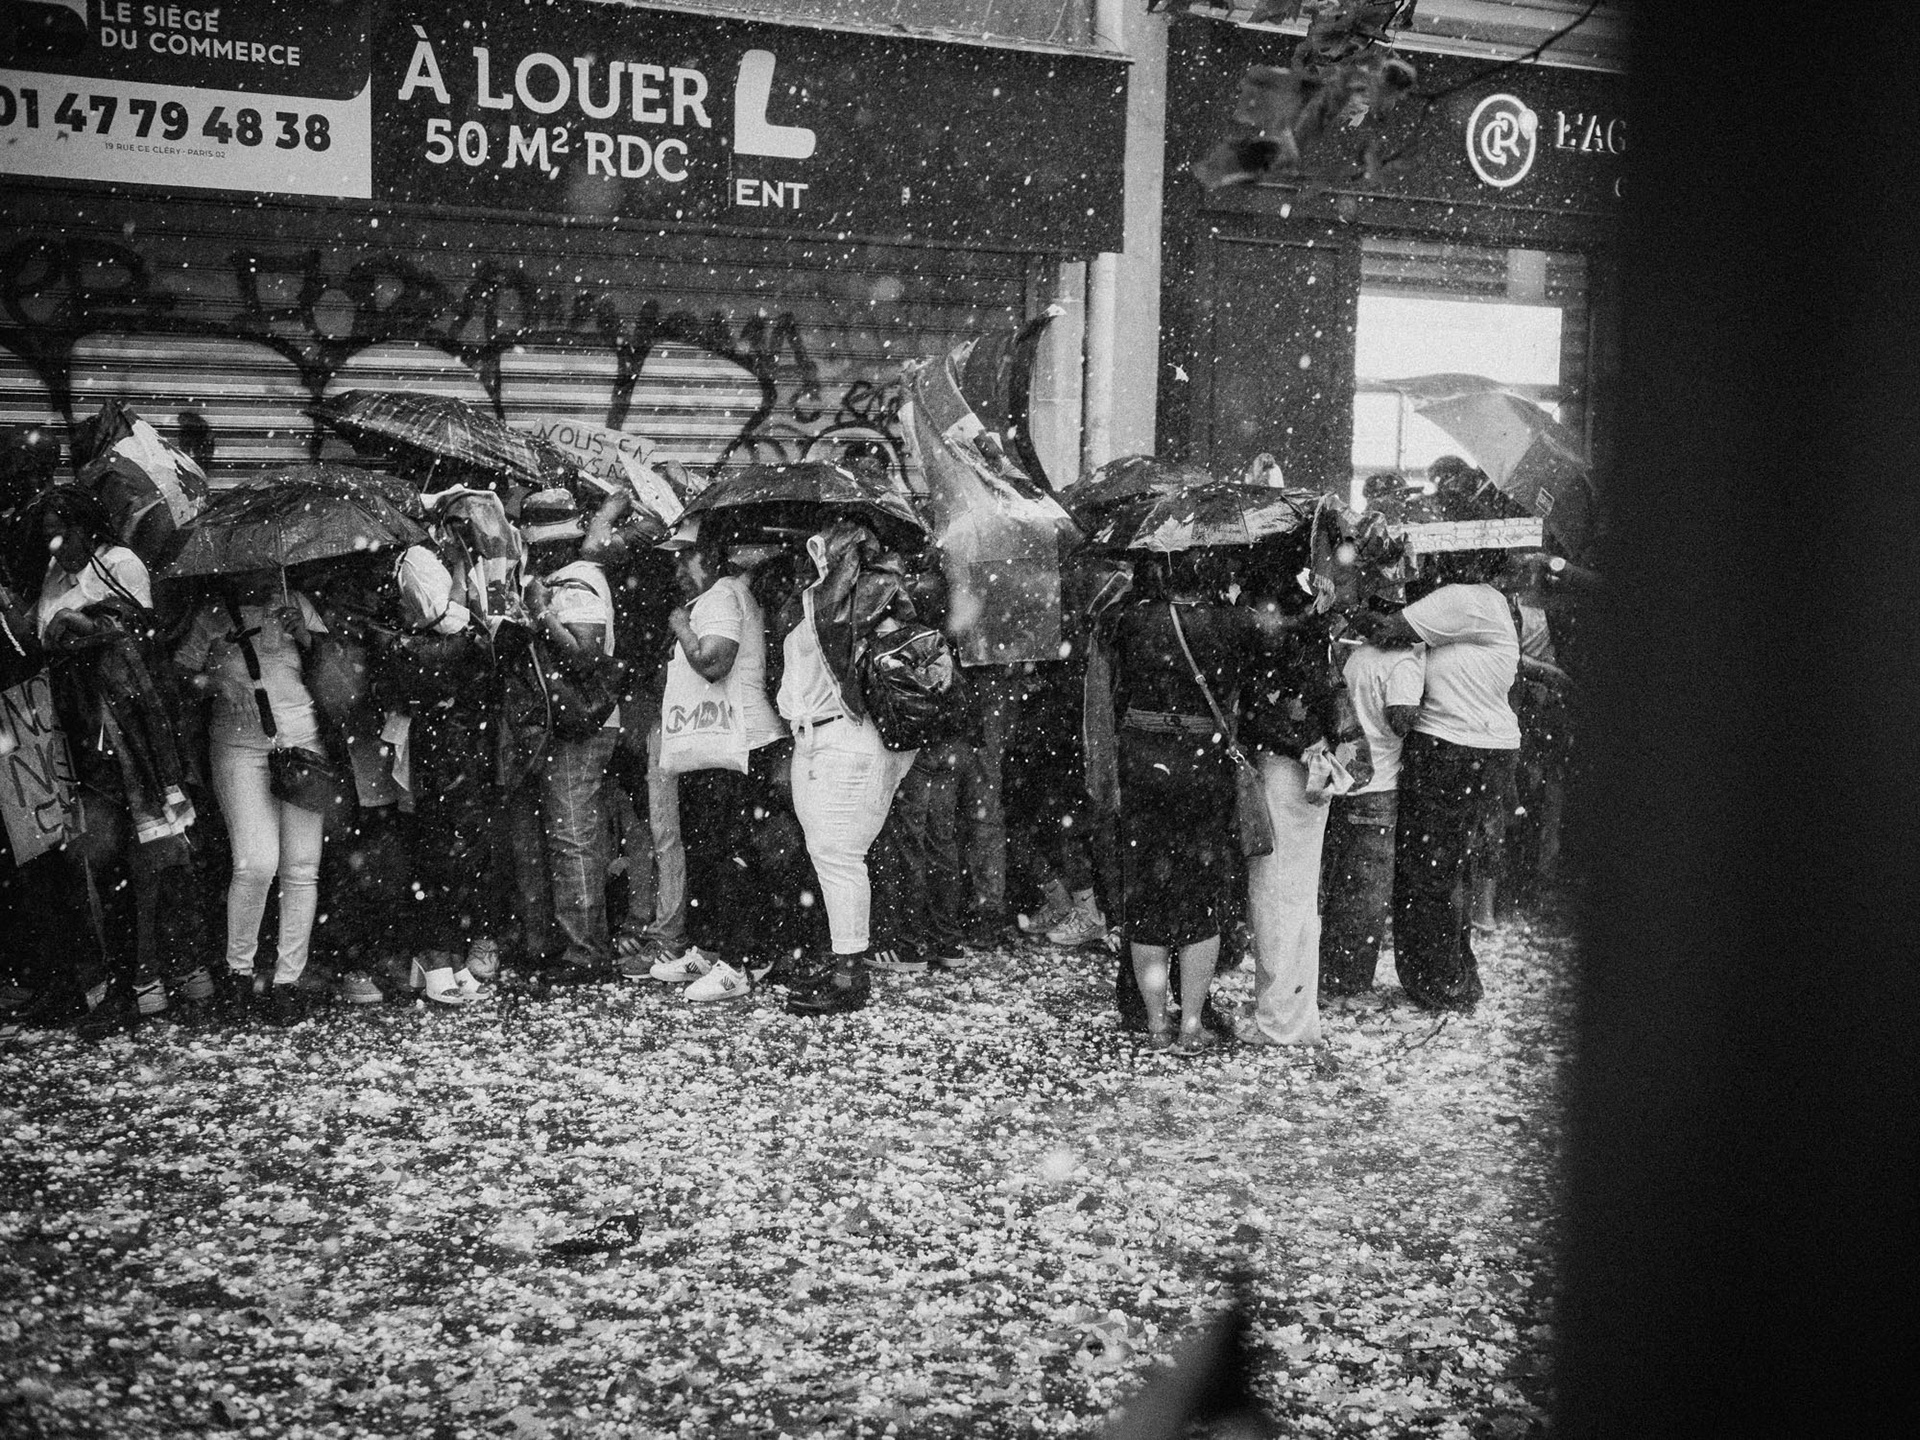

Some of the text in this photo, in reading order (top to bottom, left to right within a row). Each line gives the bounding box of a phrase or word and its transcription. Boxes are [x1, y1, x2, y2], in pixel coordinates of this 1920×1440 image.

[101, 1, 219, 33] LE SIÈGE
[101, 26, 300, 67] DU COMMERCE
[398, 25, 711, 128] À LOUER
[54, 92, 118, 135] 47
[129, 98, 189, 141] 79
[202, 106, 263, 147] 48
[275, 111, 331, 152] 38
[187, 148, 213, 158] PARIS
[425, 119, 488, 166] 50
[584, 131, 689, 182] RDC
[736, 178, 809, 210] ENT
